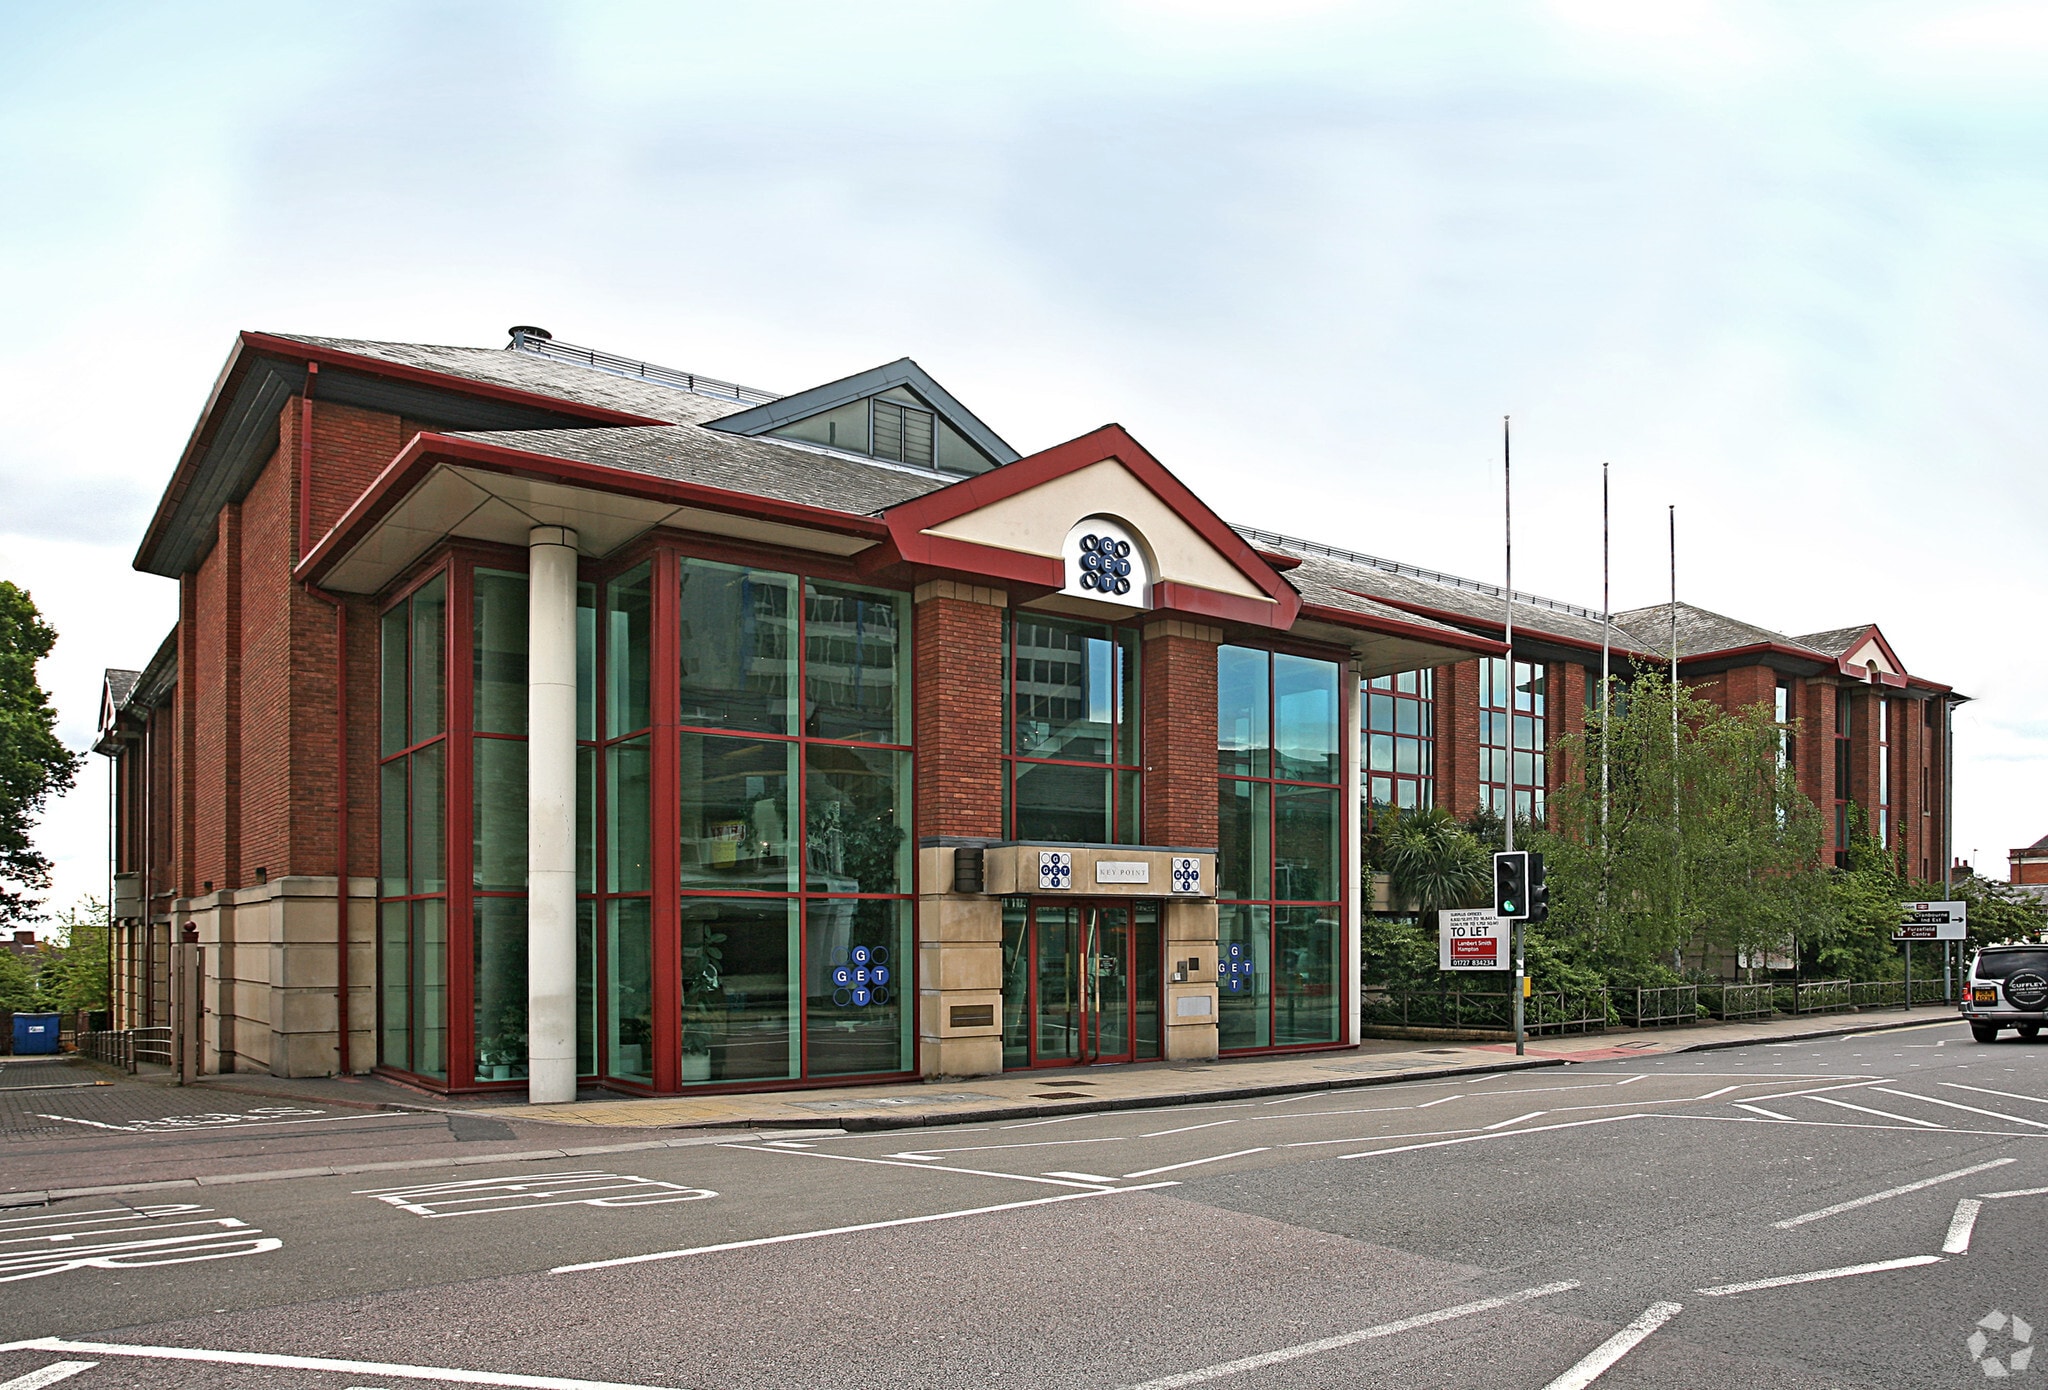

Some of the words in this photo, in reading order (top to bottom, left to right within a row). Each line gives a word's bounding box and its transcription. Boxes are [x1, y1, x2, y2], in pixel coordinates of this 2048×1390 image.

[1450, 927, 1465, 936] TO
[1470, 926, 1489, 936] LET
[351, 1169, 721, 1219] KEEP
